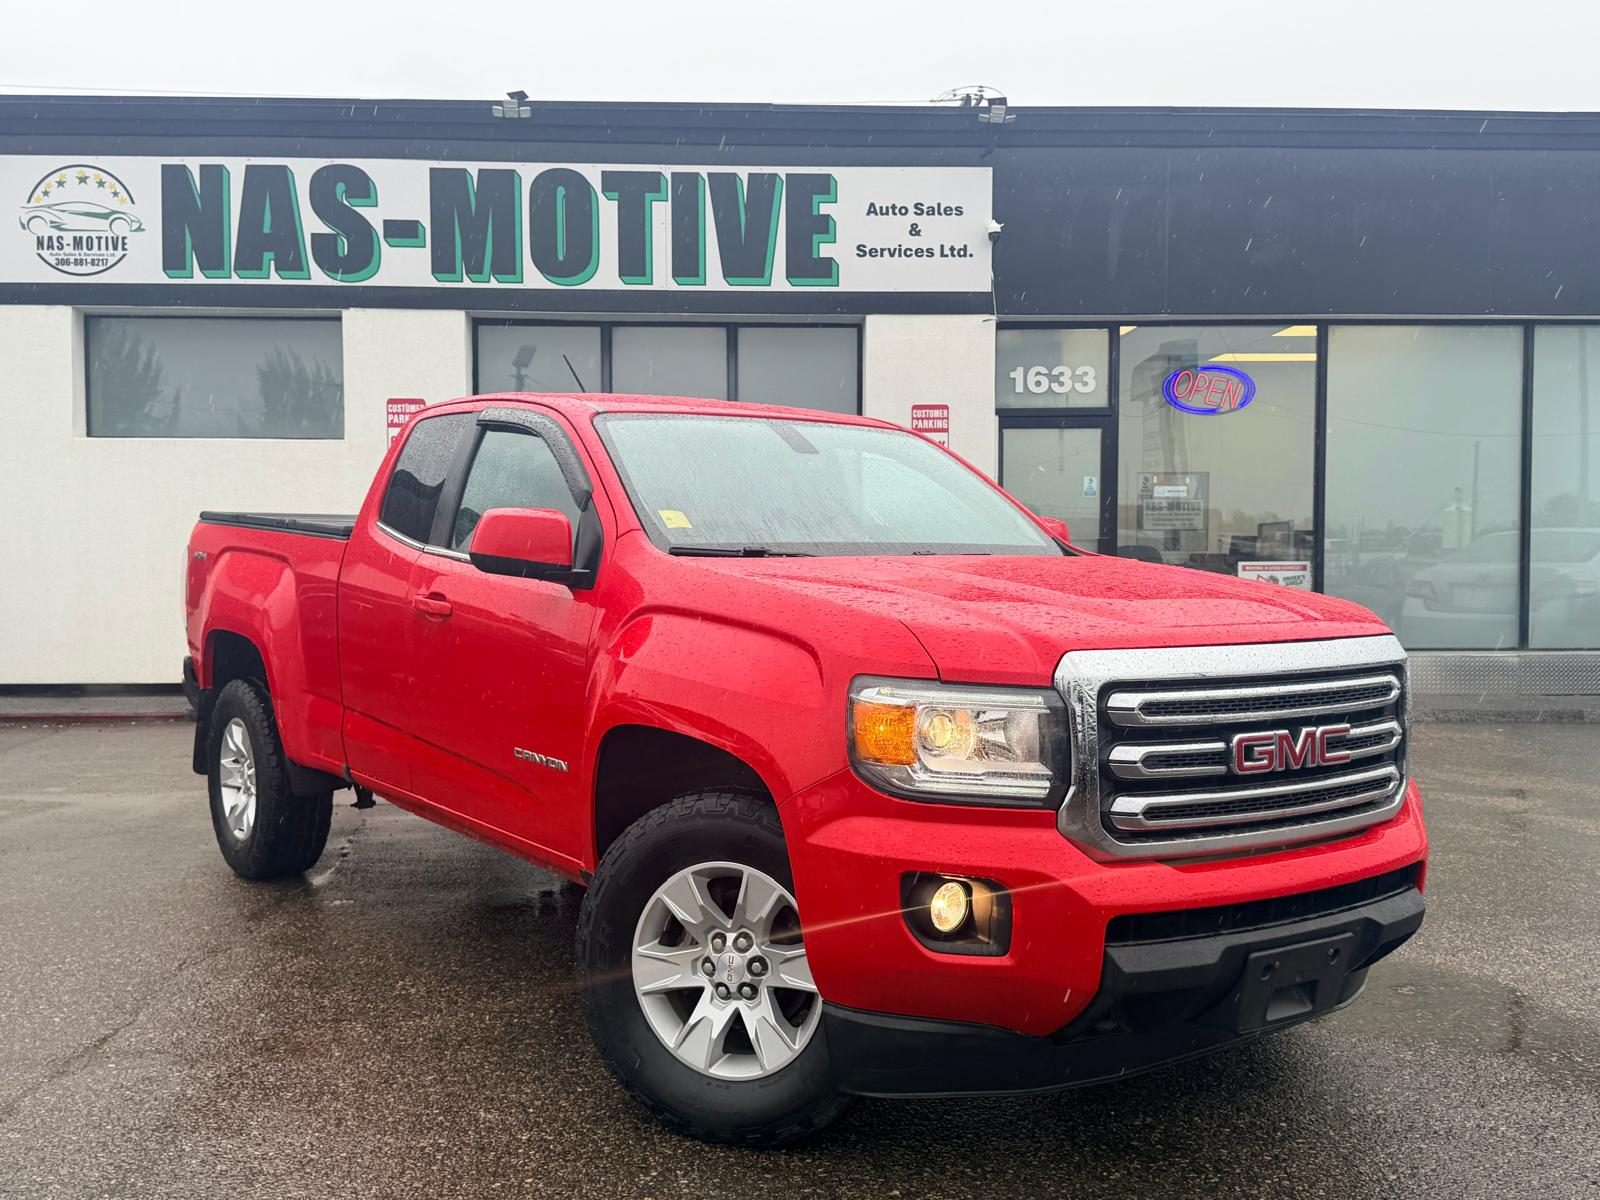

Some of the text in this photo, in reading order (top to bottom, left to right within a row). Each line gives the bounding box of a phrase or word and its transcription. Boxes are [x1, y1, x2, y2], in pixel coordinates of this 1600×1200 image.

[866, 202, 964, 216] Auto Sales
[161, 163, 839, 287] NAS-MOTIVE
[908, 223, 922, 237] &
[36, 235, 128, 251] NAS-MOTIVE
[855, 244, 974, 258] Services Ltd.
[1009, 366, 1097, 394] 1633
[1173, 369, 1243, 410] OPEN
[388, 403, 425, 413] CUSTOME
[912, 409, 948, 418] CUSTOMER
[388, 414, 411, 424] PARK
[912, 419, 948, 429] PARKING
[1232, 724, 1351, 775] GMC
[513, 746, 569, 773] CANYON
[726, 955, 735, 982] GMC
